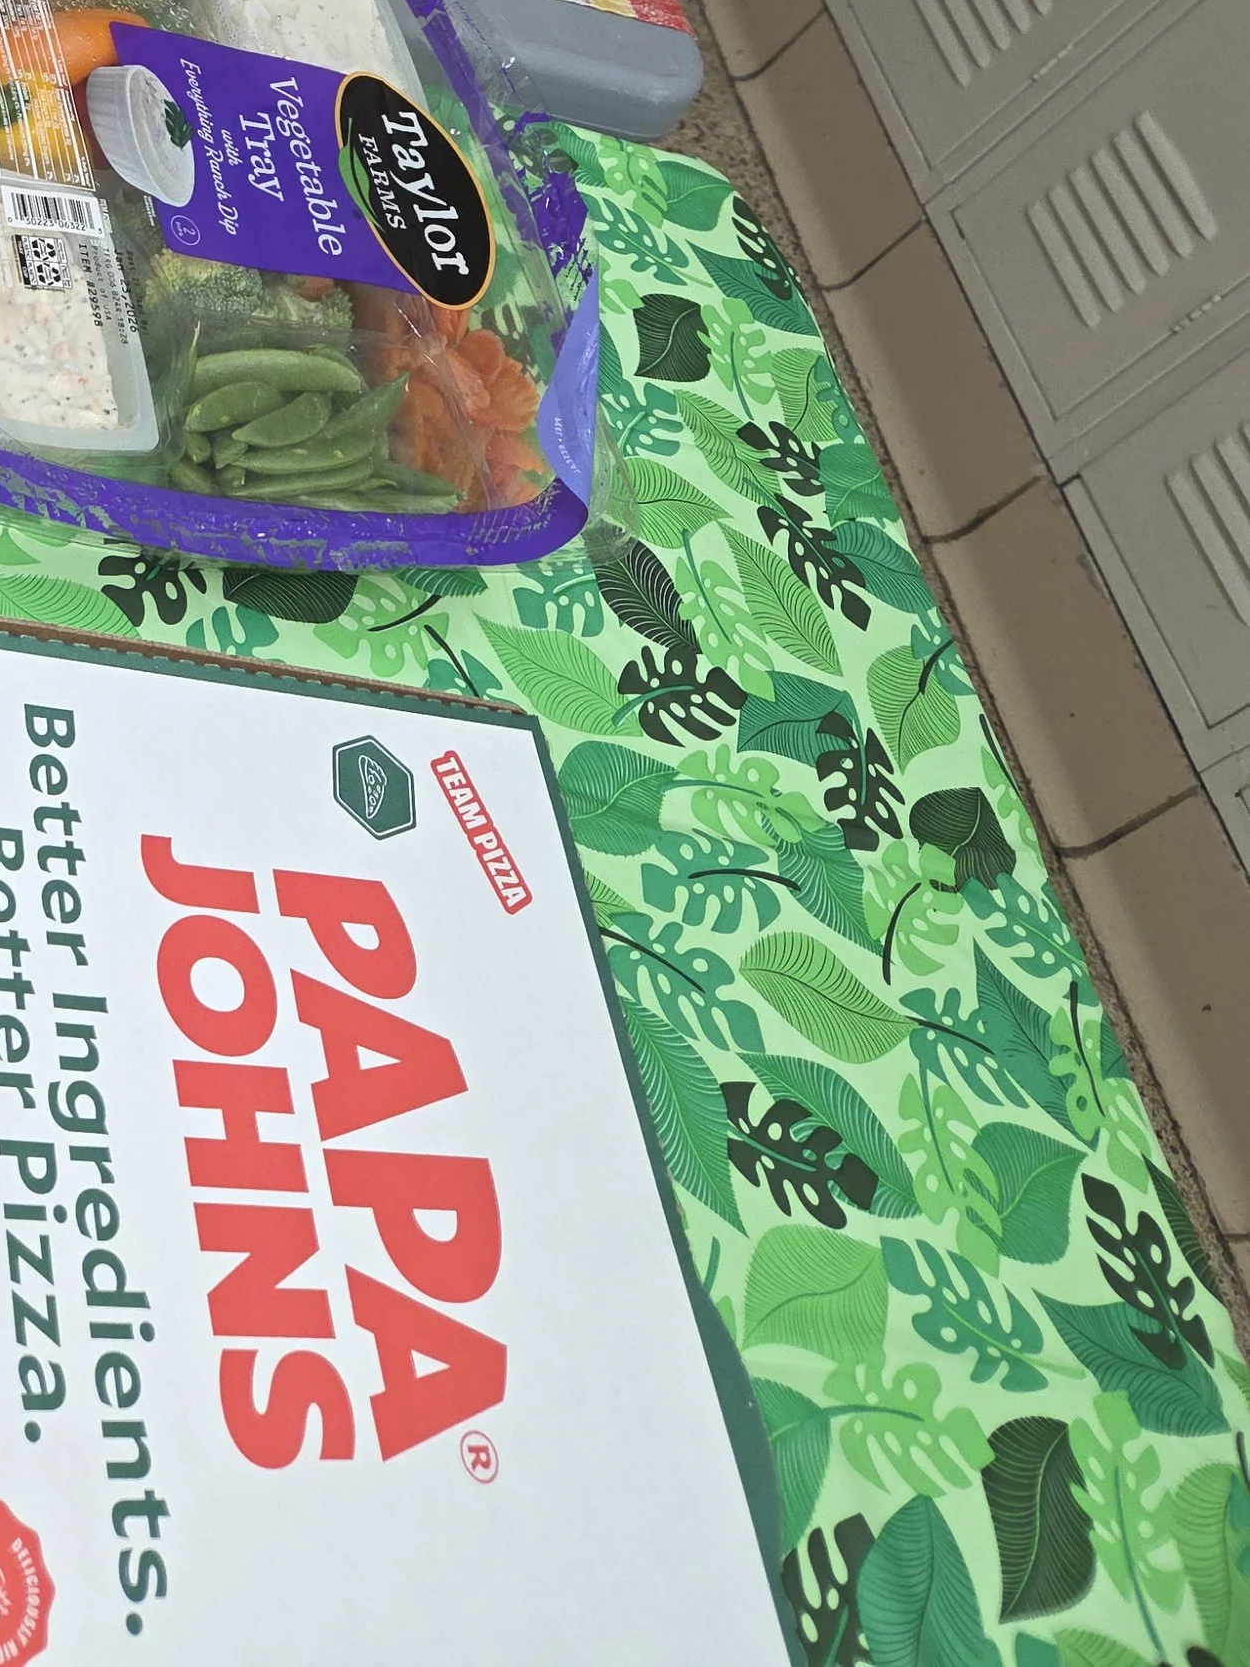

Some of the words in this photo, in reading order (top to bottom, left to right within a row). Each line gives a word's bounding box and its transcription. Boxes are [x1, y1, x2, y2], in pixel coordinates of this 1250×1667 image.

[180, 57, 214, 149] Everything
[221, 129, 243, 166] with
[205, 143, 232, 201] Ranch
[239, 112, 283, 202] Tray
[268, 76, 346, 256] Vegetable
[358, 134, 407, 230] FARMS
[382, 111, 470, 275] Taylor
[79, 243, 93, 273] ITEM
[113, 248, 127, 271] Jan
[216, 201, 239, 236] Dip
[85, 280, 104, 327] #29598
[91, 245, 105, 283] Product
[103, 303, 112, 321] USA
[118, 278, 139, 333] 23,2026
[24, 704, 88, 967] Better
[437, 757, 487, 830] TEAM
[474, 831, 527, 907] PIZZA
[141, 834, 355, 1470] JOHNS
[274, 869, 507, 1461] PAPA
[0, 1141, 65, 1442] Pizza.
[54, 995, 167, 1636] Ingredients.
[11, 1537, 41, 1647] DELICIOUSLY
